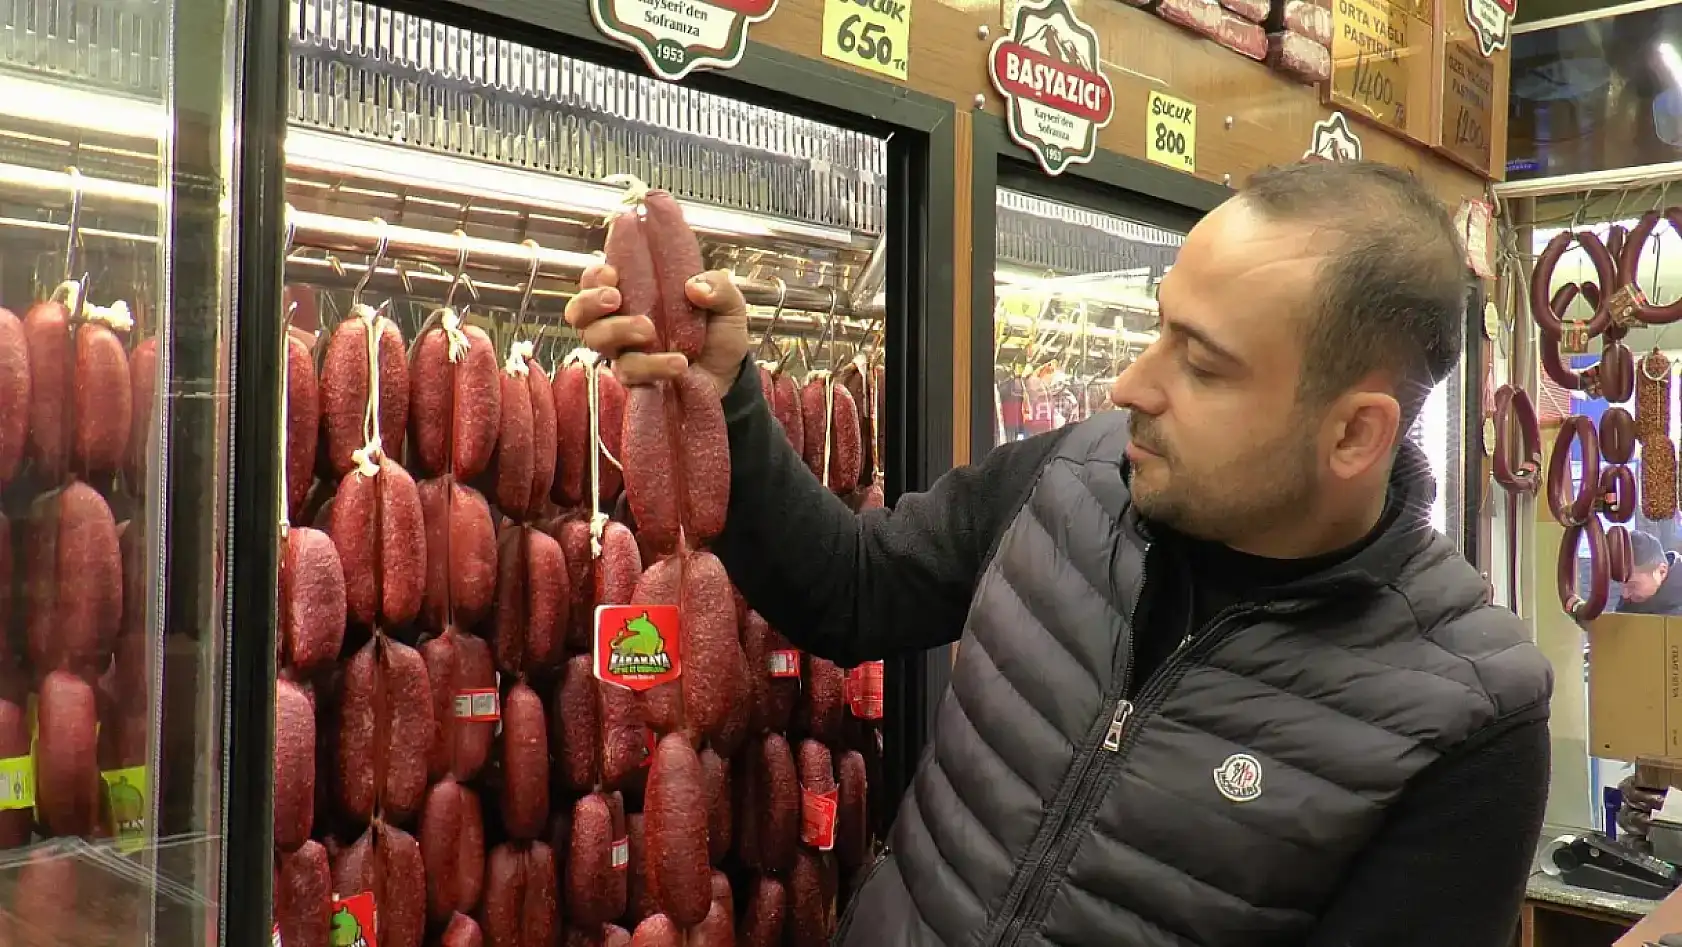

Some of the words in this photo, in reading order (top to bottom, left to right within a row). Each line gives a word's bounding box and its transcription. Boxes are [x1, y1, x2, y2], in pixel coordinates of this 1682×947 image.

[644, 10, 700, 37] Sofranıza
[1340, 0, 1370, 28] ORTA
[656, 43, 684, 63] 1953
[837, 14, 892, 65] 650
[1006, 52, 1100, 111] BAŞYAZICI
[1152, 96, 1193, 125] SUCUK
[1156, 122, 1186, 155] 800
